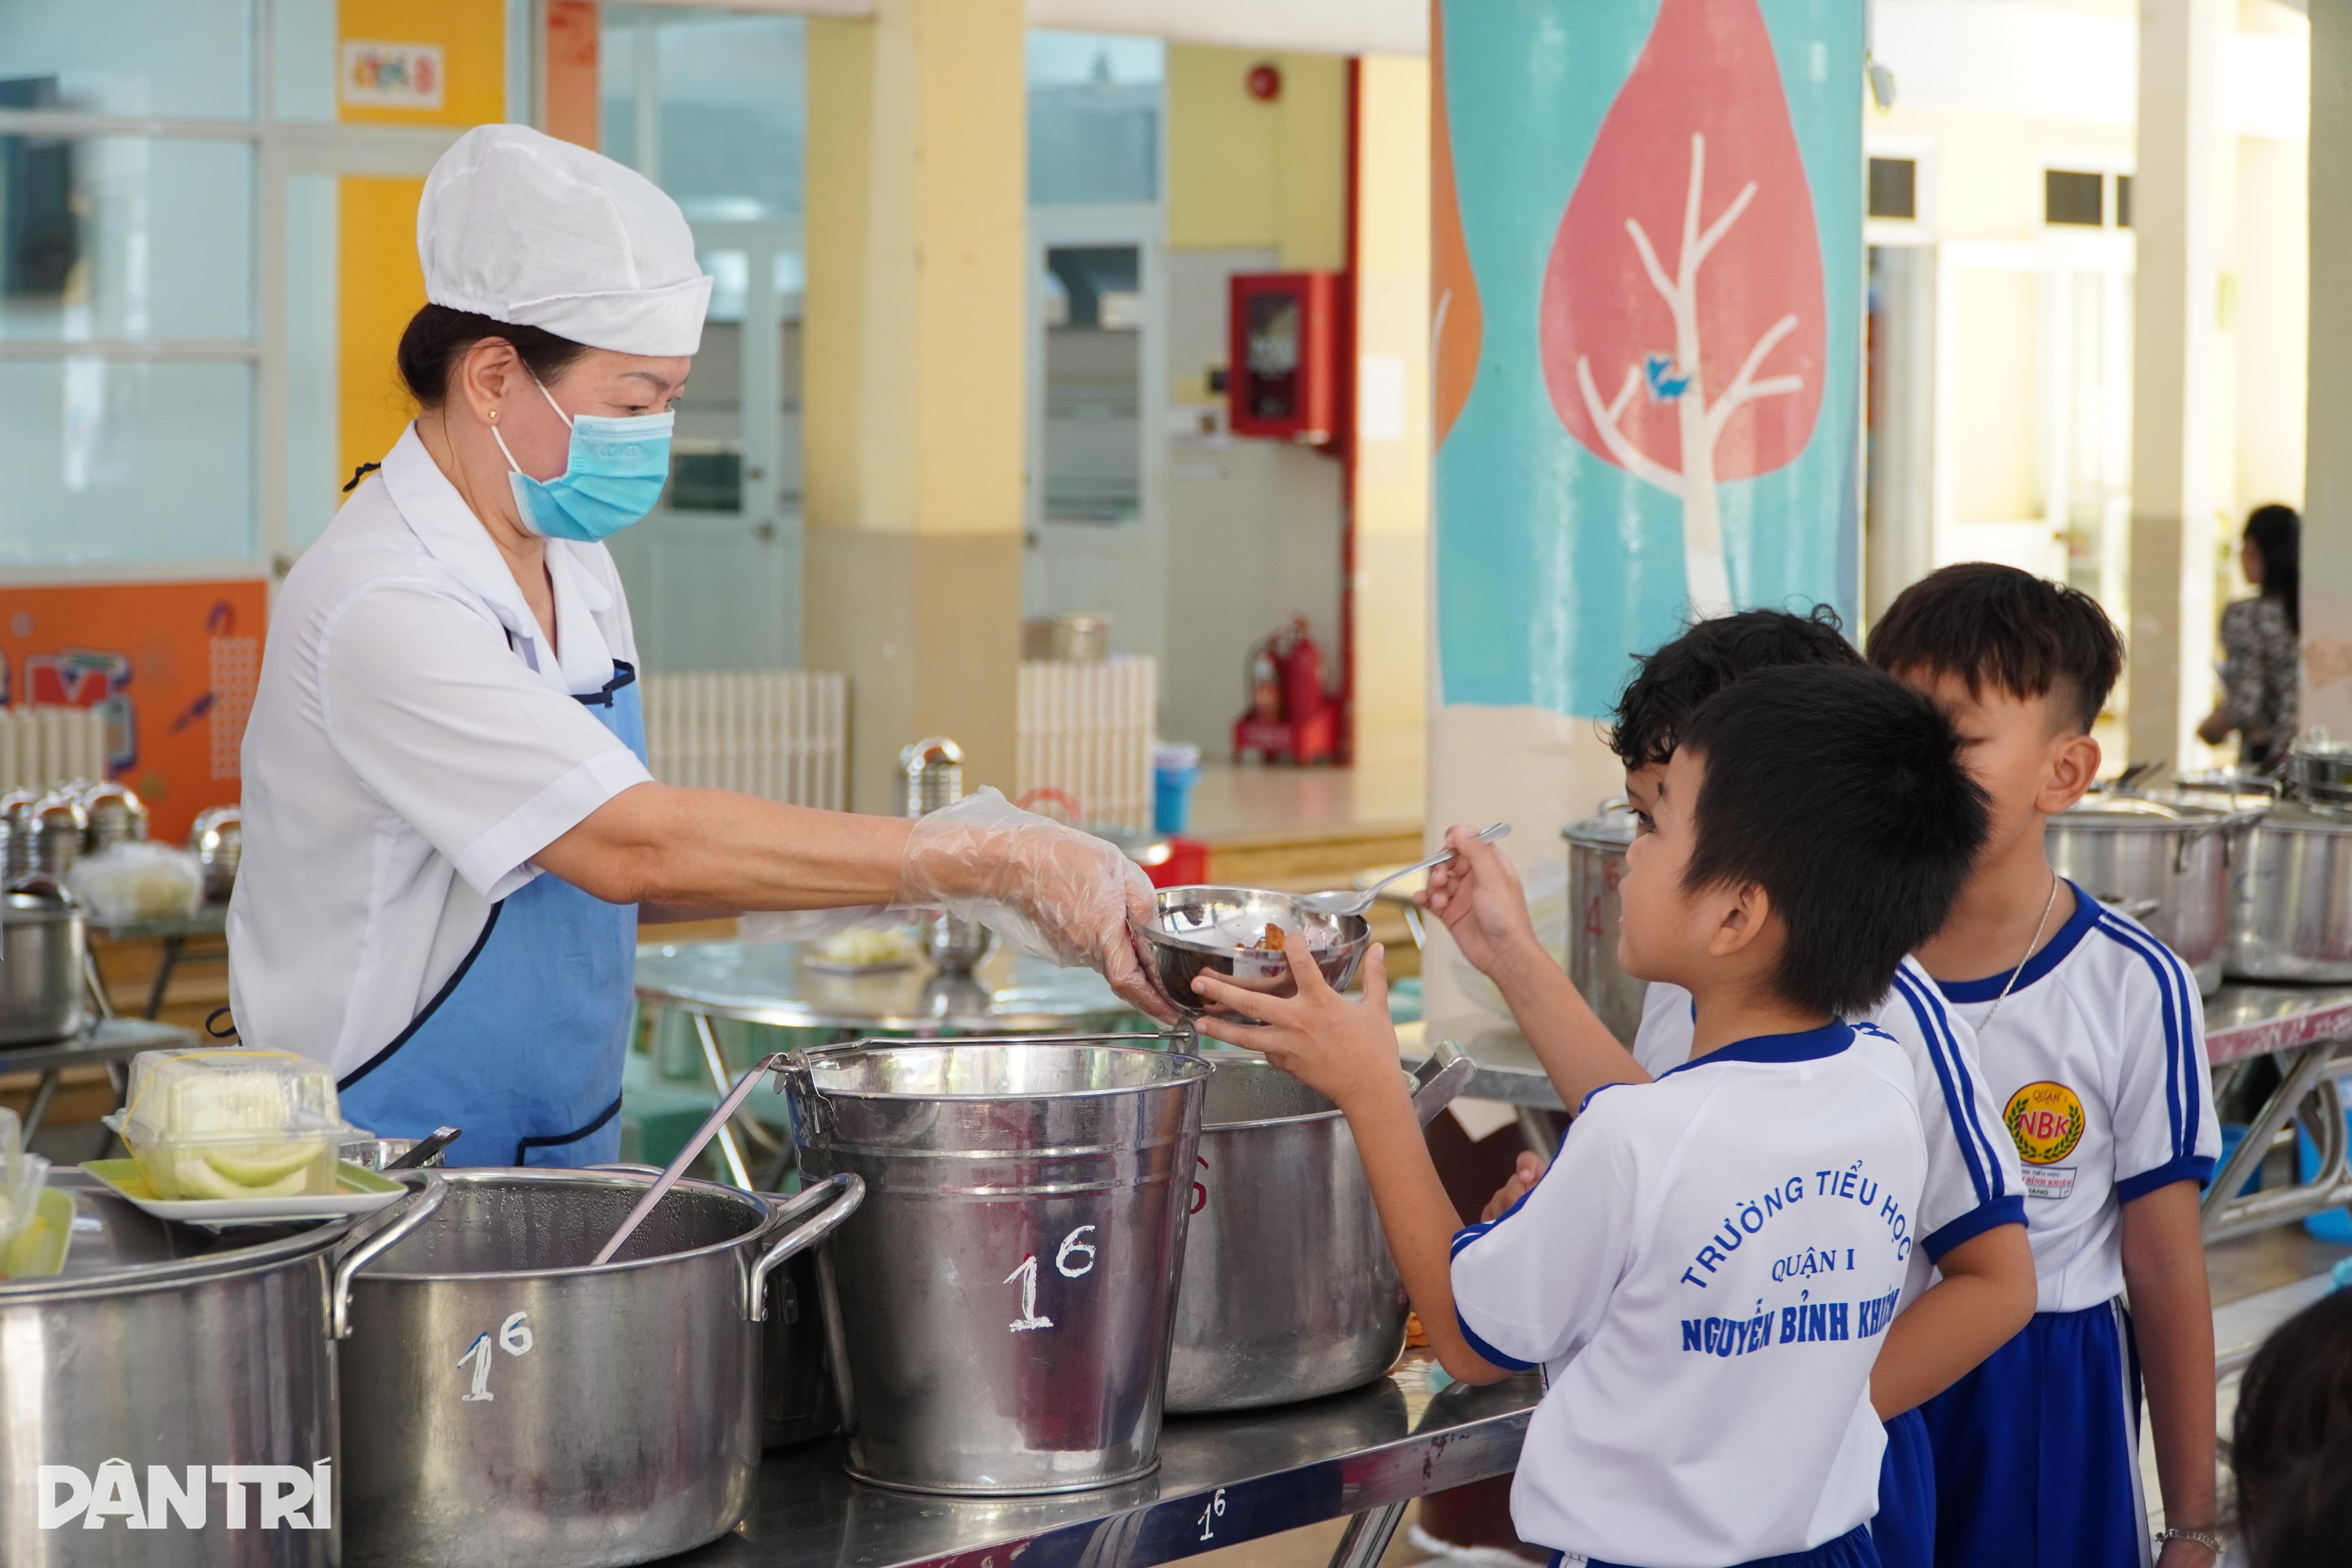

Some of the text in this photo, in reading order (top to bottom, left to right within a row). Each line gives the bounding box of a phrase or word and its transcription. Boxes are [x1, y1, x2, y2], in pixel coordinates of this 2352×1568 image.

[2018, 1109, 2071, 1139] NBK
[1680, 1160, 1911, 1289] TRƯỜNG TIỂU HỌC
[1771, 1246, 1837, 1283] QUẬN
[1779, 1289, 1849, 1344] BỈNH
